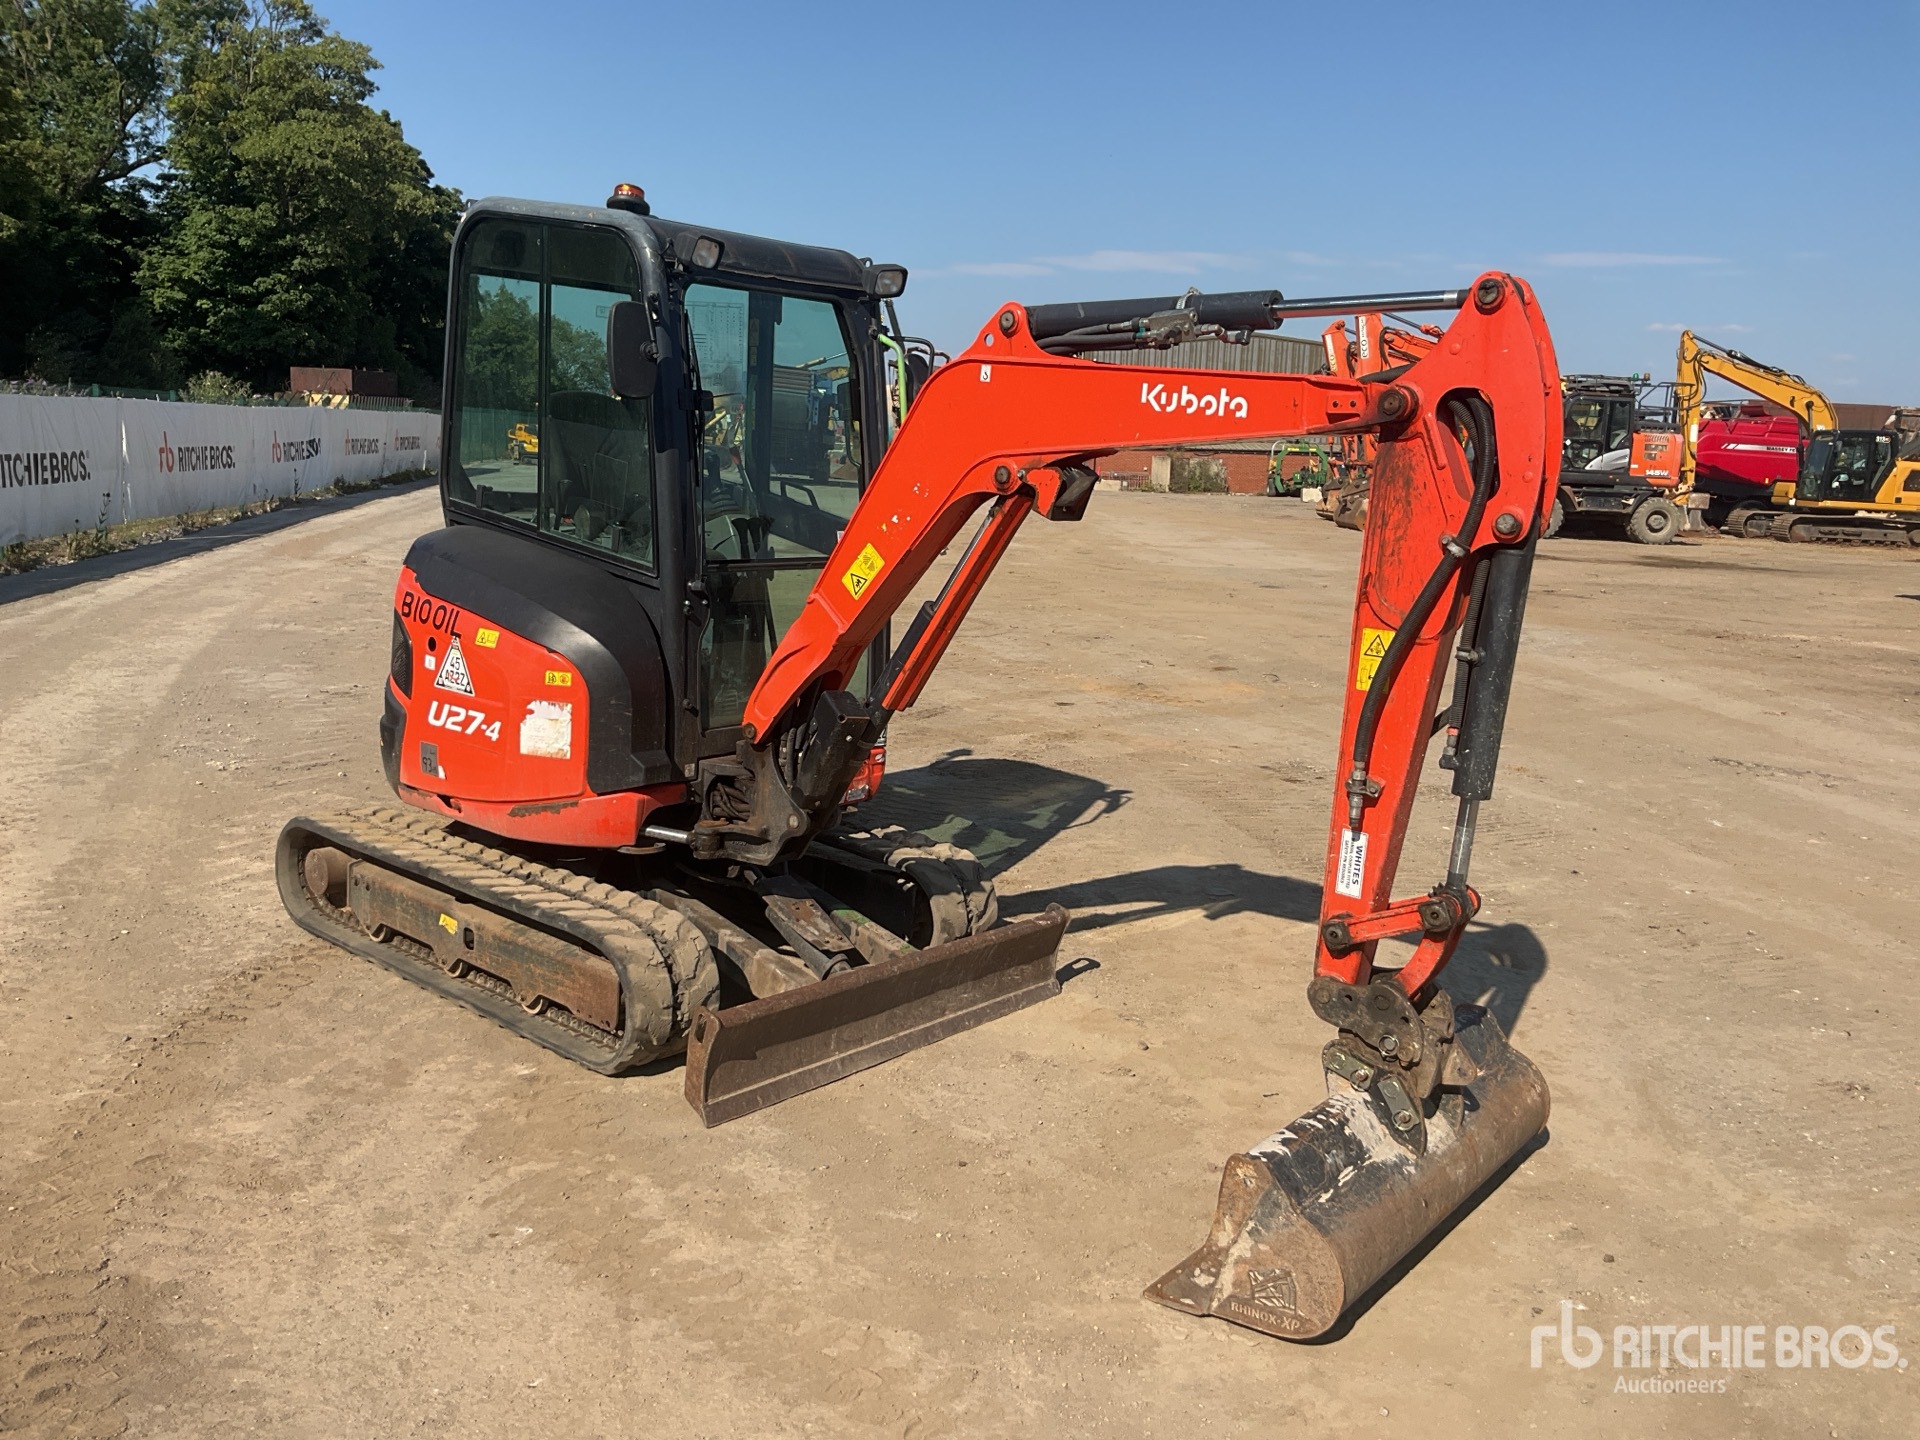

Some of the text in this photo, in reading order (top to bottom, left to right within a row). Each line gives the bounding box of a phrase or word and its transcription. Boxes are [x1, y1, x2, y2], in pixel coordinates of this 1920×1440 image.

[1141, 383, 1248, 418] Kubota
[0, 452, 48, 488] ITCHIE
[178, 446, 208, 472] RITCHIE
[209, 445, 235, 470] BROS.
[428, 700, 502, 742] U27-4
[1352, 845, 1363, 886] WHITES
